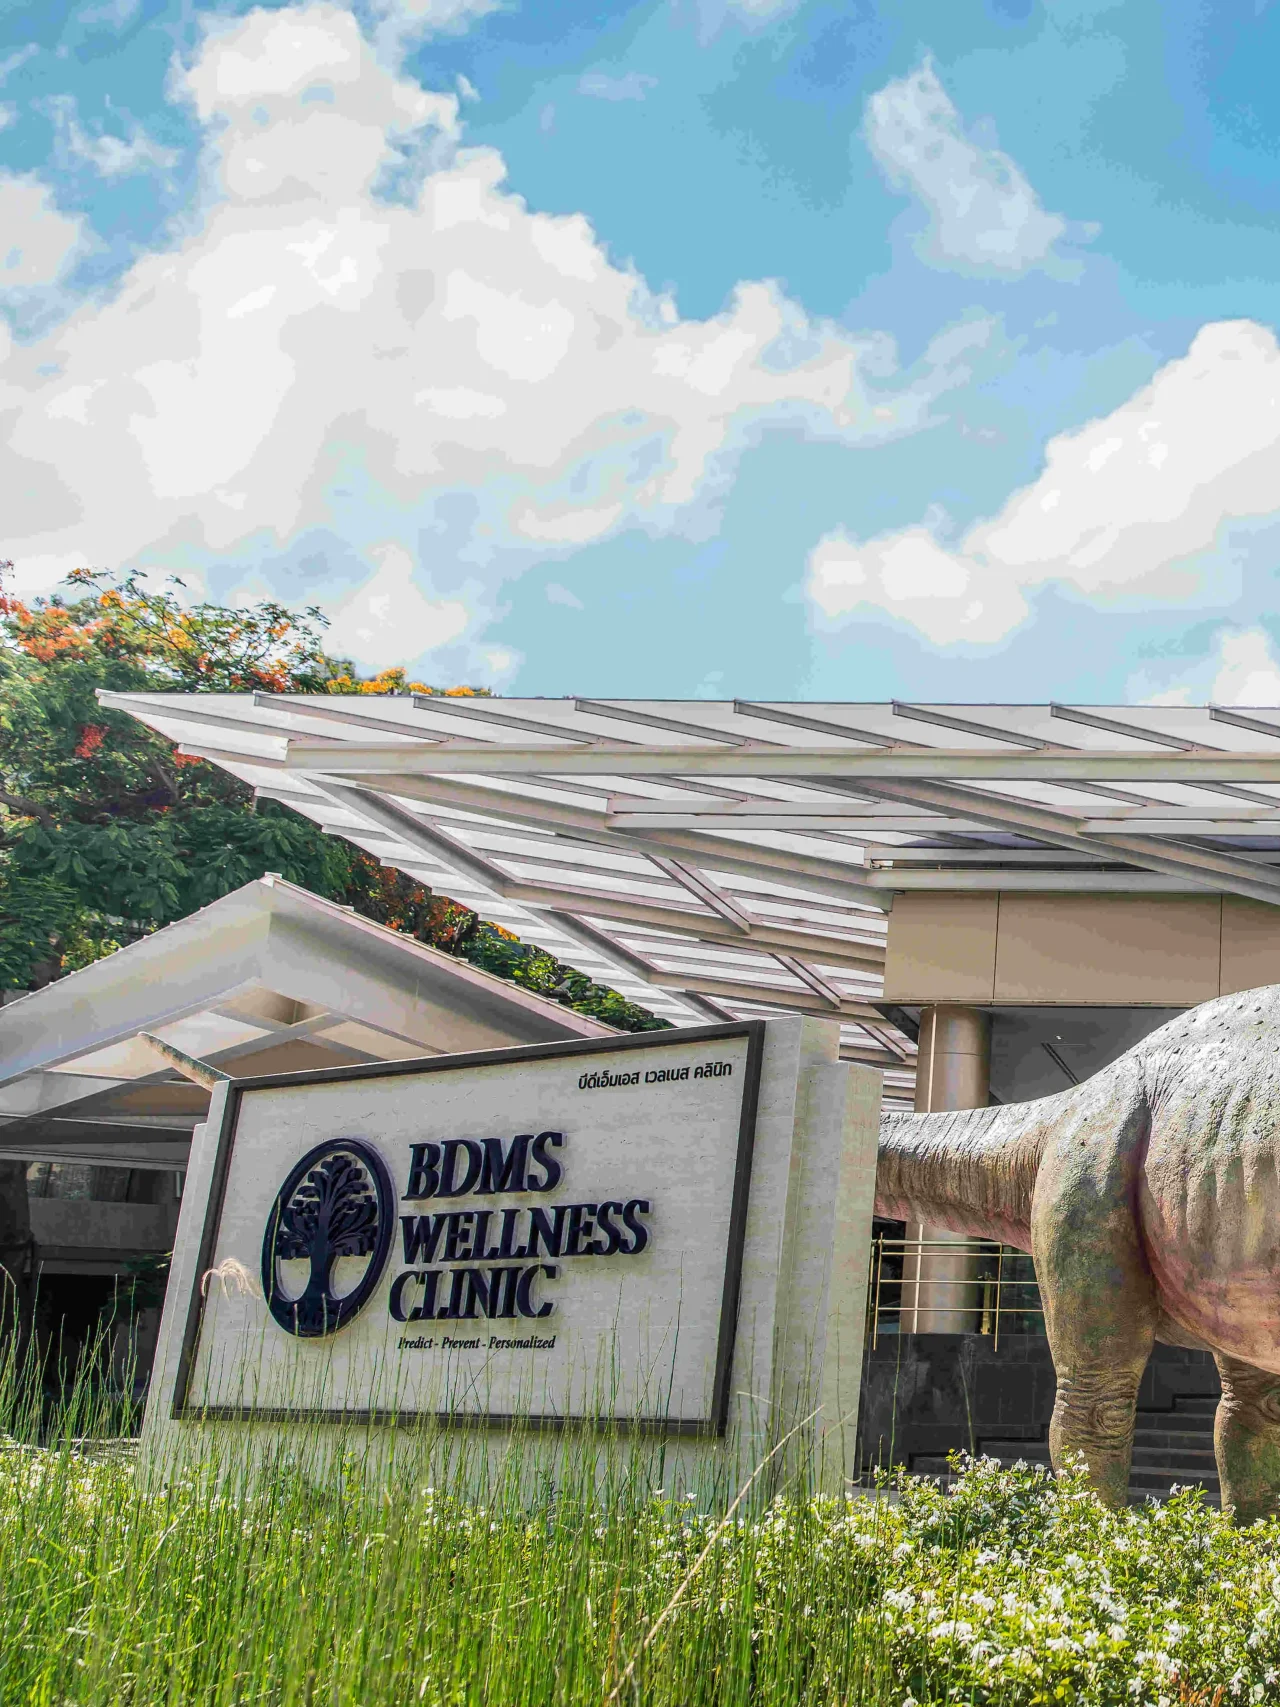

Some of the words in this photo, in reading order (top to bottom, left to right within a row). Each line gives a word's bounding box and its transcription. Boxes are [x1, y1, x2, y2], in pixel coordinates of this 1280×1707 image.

[578, 1070, 641, 1090] บีดีเอ็มเอส
[644, 1066, 691, 1084] เวลเนส
[693, 1061, 733, 1079] คลินิก
[401, 1131, 564, 1201] BDMS
[399, 1199, 650, 1265] WELLNESS
[388, 1264, 558, 1322] CLINIC
[397, 1336, 434, 1350] Predict
[441, 1336, 480, 1350] Prevent
[487, 1334, 557, 1350] Personalized
